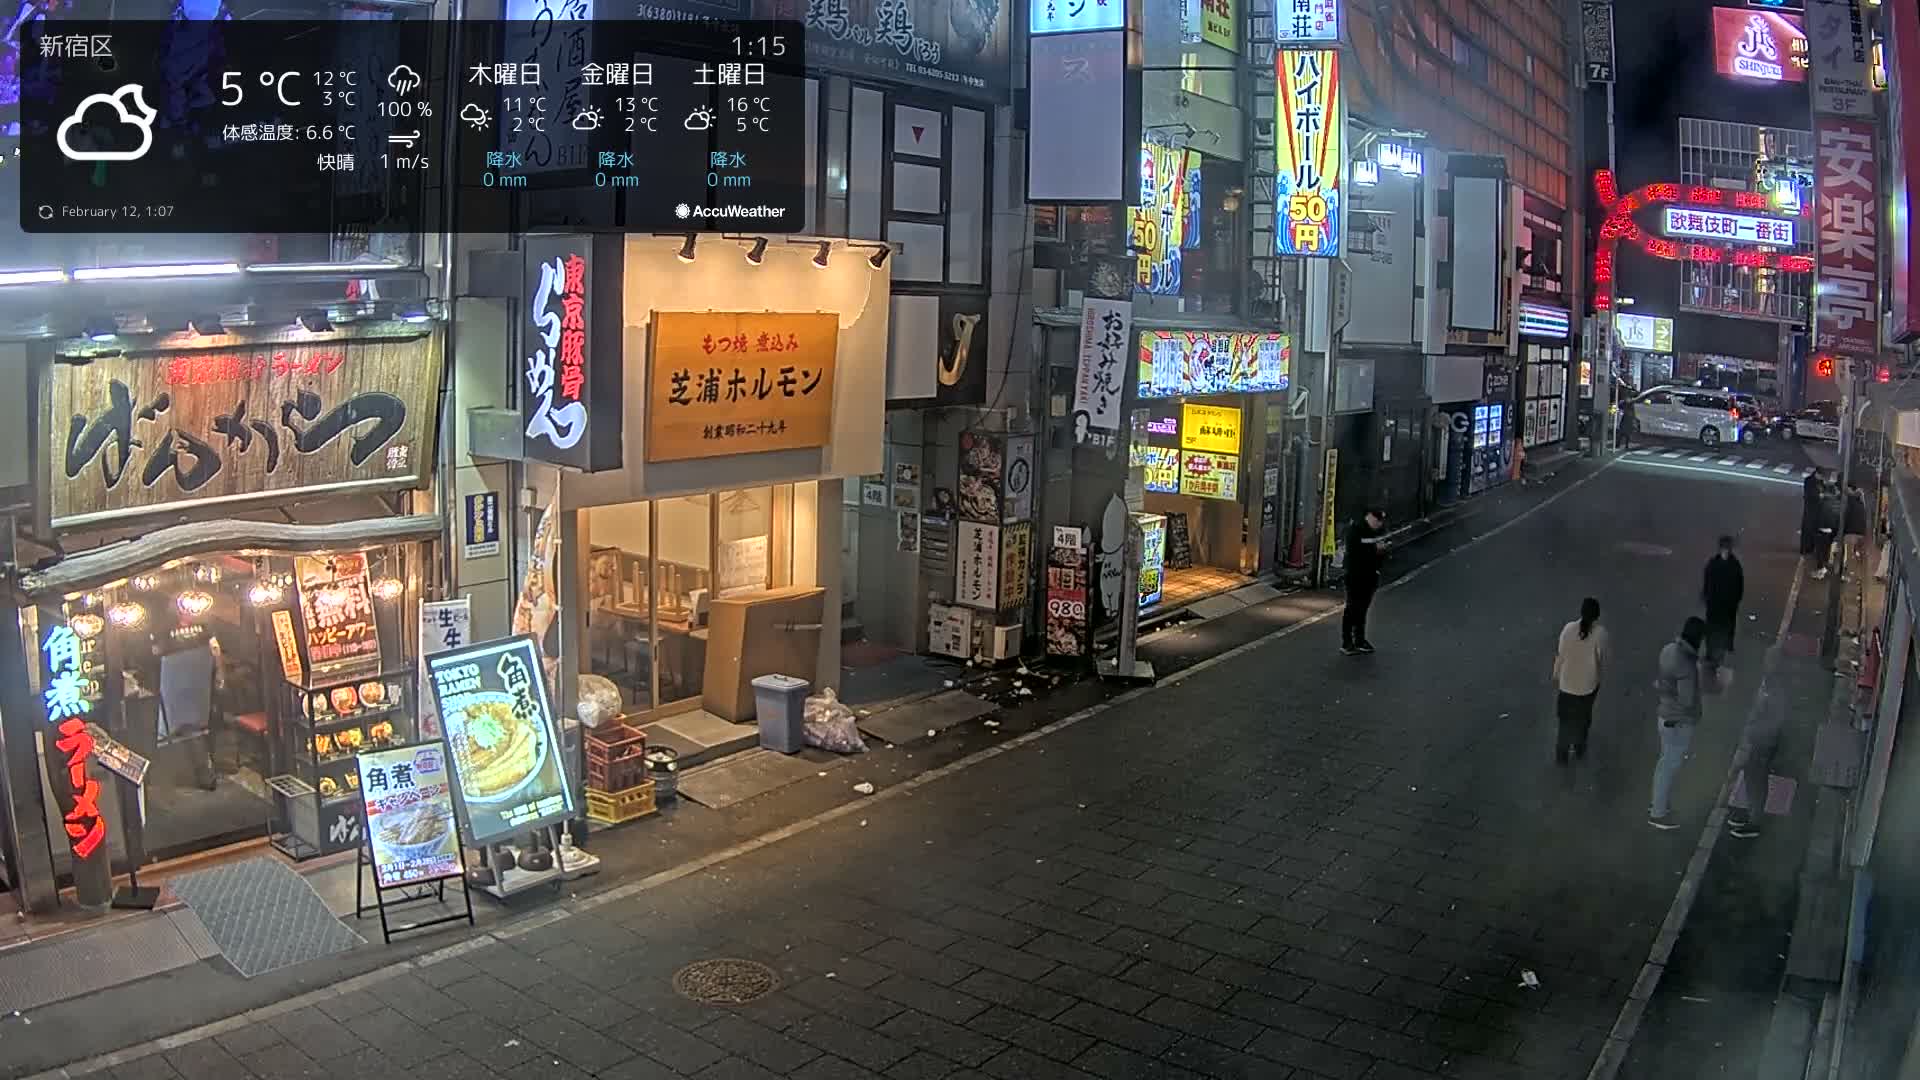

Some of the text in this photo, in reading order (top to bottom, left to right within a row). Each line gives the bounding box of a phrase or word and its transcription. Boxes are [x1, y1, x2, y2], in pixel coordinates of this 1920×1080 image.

[1589, 63, 1609, 79] 7F
[1288, 50, 1328, 252] ハイボール 50円
[1670, 211, 1789, 242] 歌舞伎町一番街
[1820, 126, 1876, 331] 安楽亭
[559, 253, 585, 400] 東京豚骨
[702, 331, 800, 355] もつ焼 煮込み
[1092, 309, 1124, 416] お好み焼き
[668, 367, 823, 406] 芝浦ホルモン
[308, 623, 376, 647] ハッピーアワー
[435, 663, 480, 684] TOKYO
[499, 653, 538, 721] 角煮
[366, 762, 415, 794] 角煮
